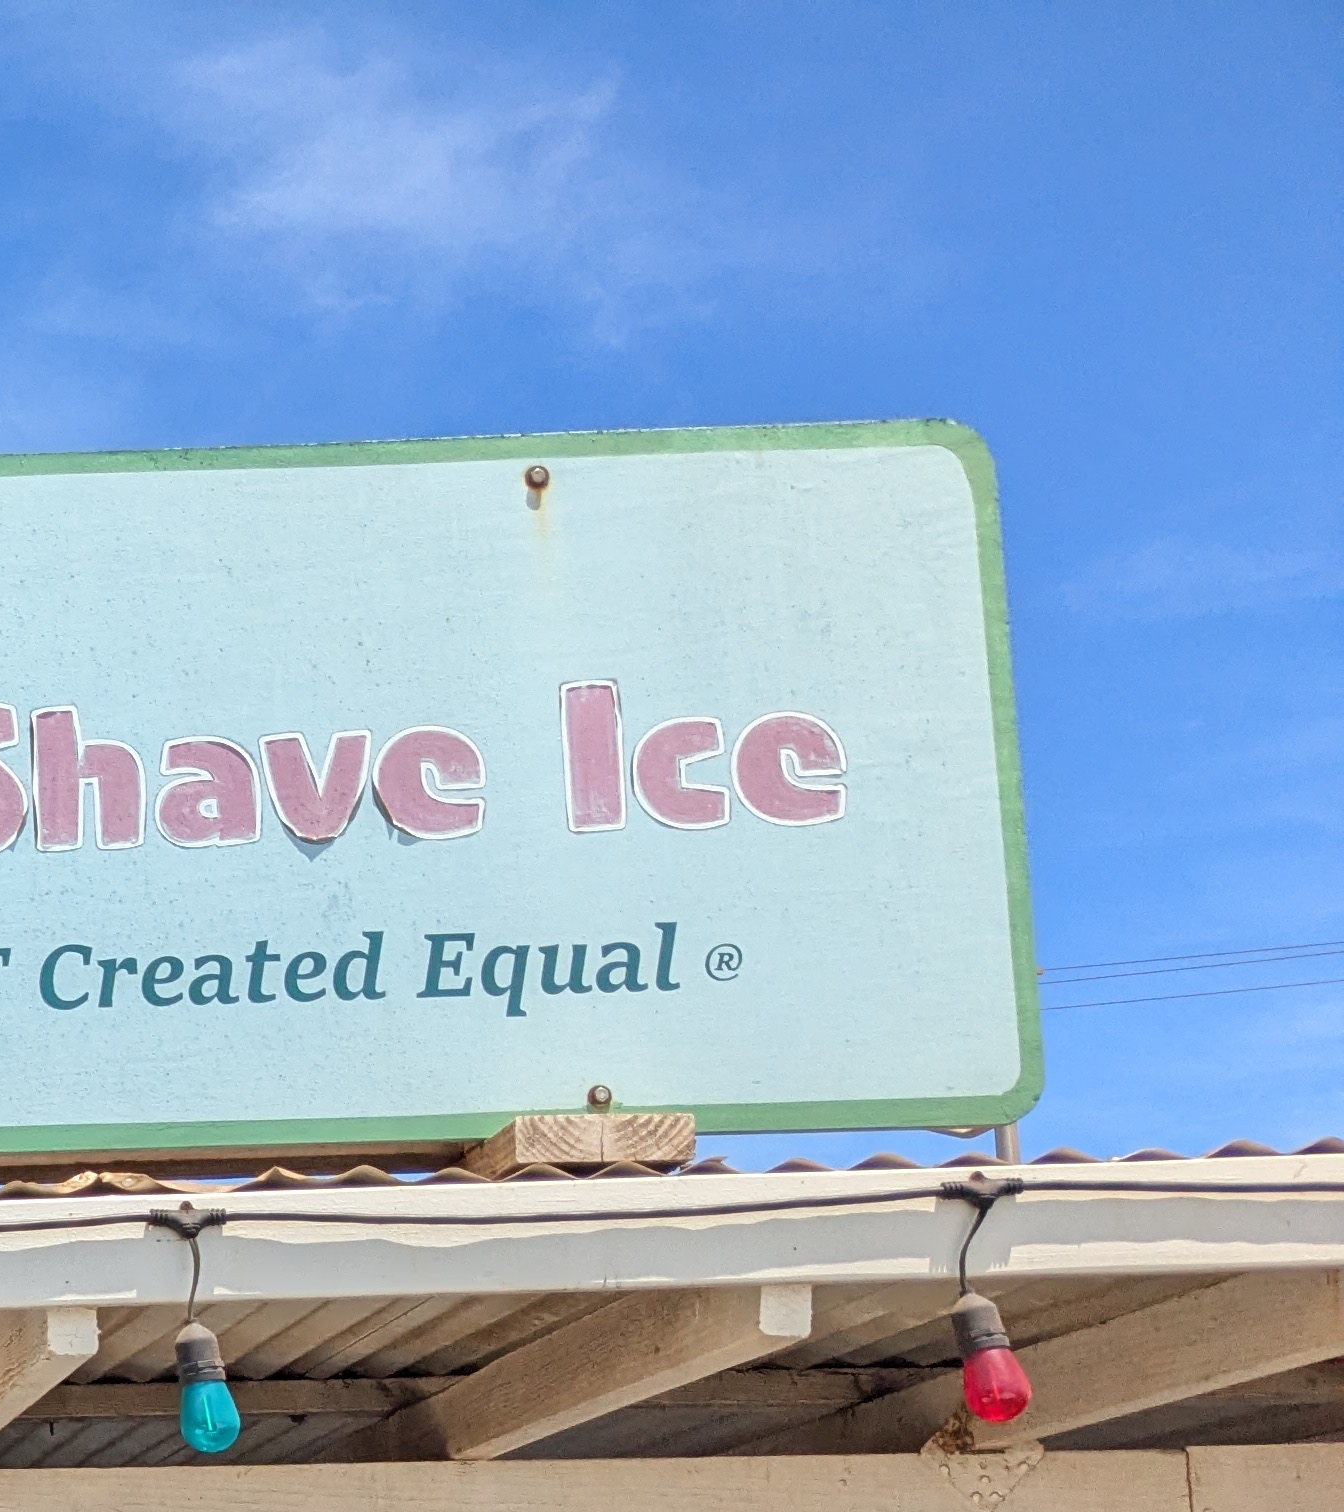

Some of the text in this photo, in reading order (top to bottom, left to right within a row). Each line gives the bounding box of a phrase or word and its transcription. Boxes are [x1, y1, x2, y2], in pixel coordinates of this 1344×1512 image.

[559, 679, 847, 832] Ice
[39, 937, 386, 1011] Created
[417, 921, 680, 1017] Equal
